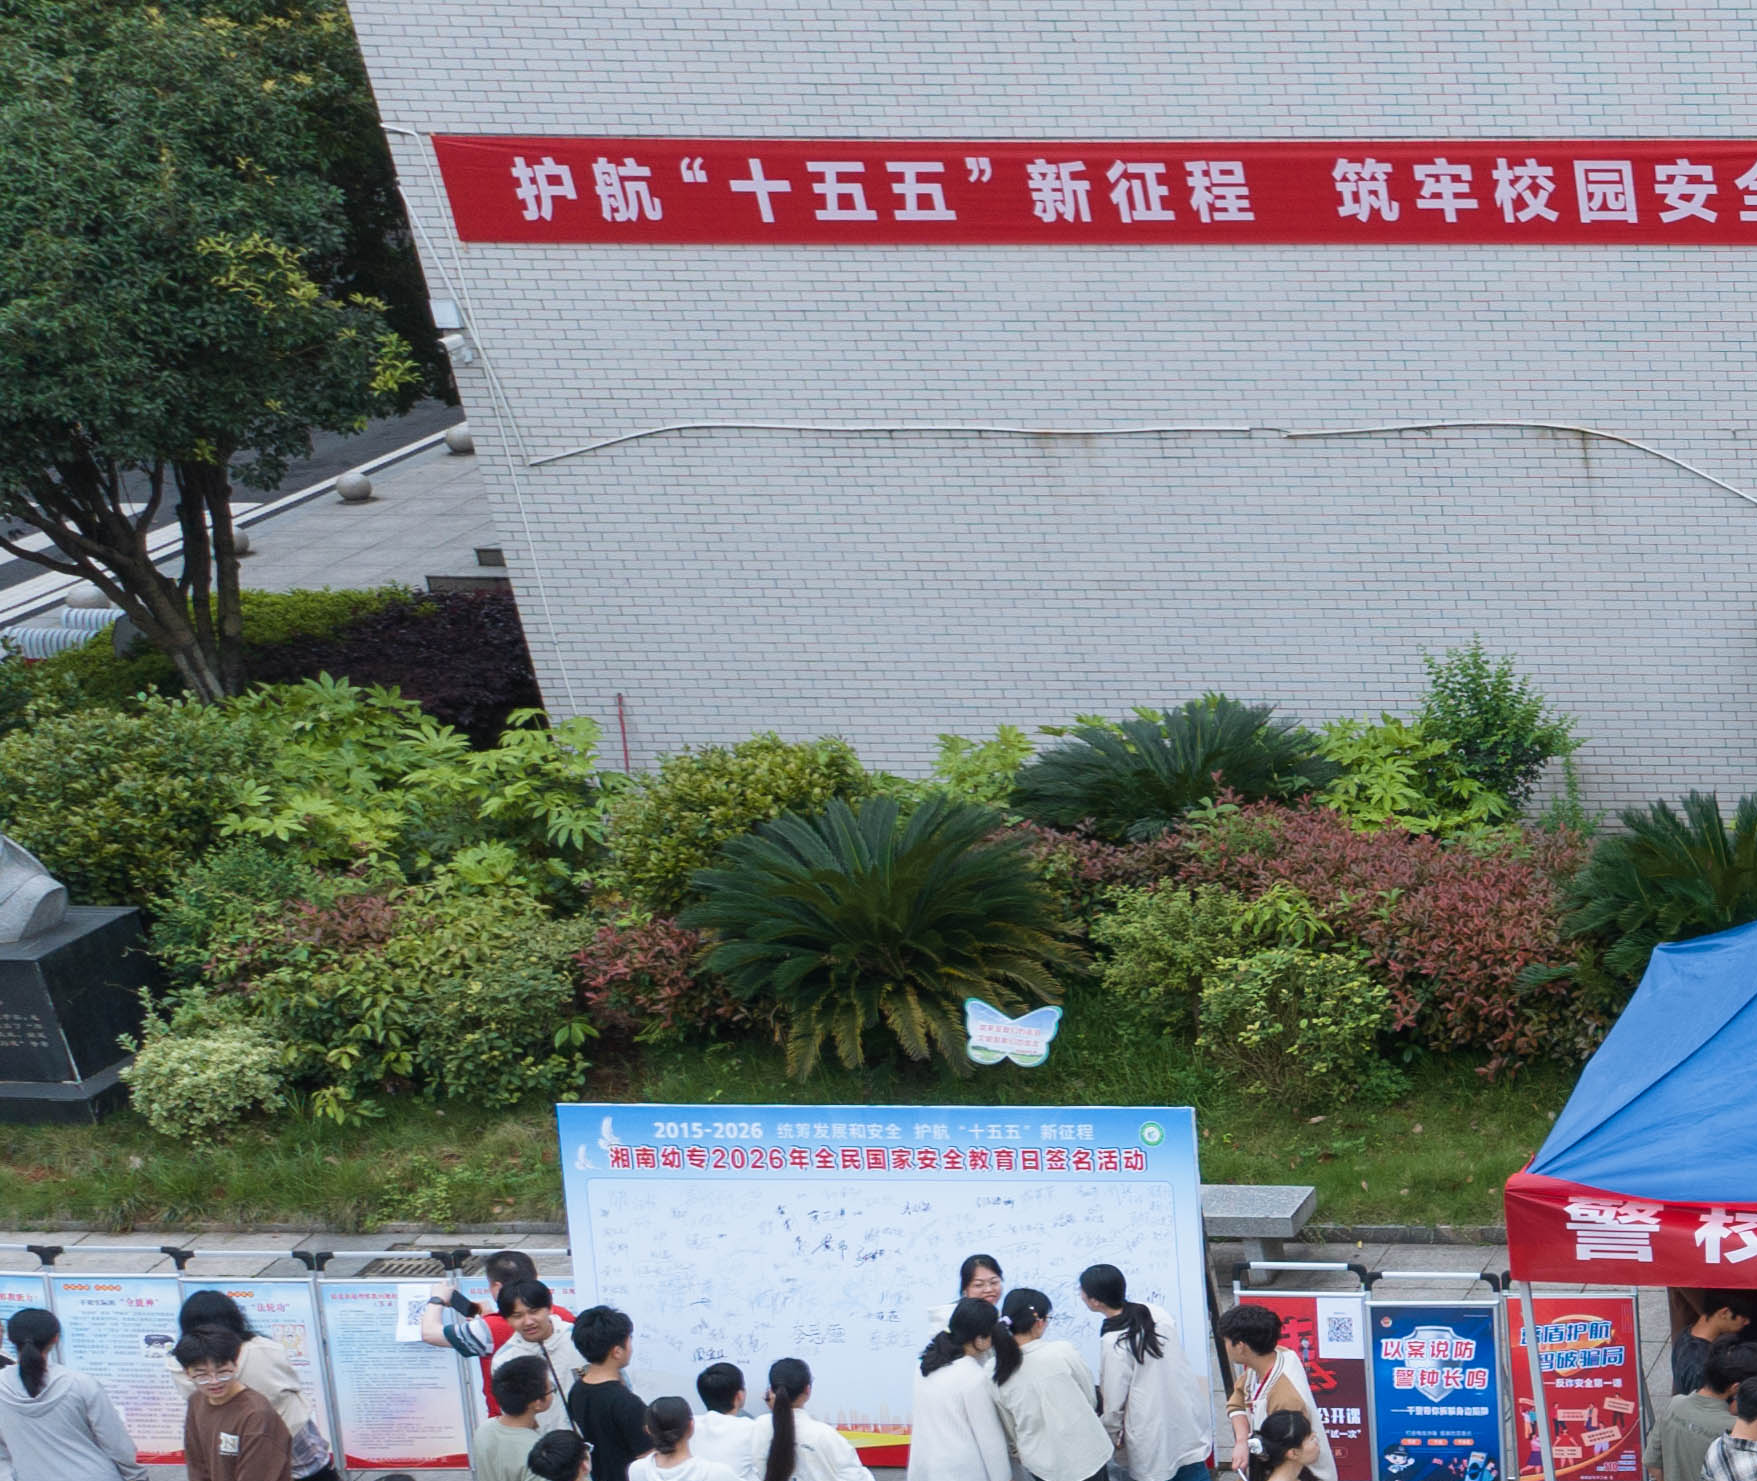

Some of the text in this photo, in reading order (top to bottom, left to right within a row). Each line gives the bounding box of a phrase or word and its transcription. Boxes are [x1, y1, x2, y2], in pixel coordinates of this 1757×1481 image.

[512, 157, 1254, 222] 护航“十五五”新征程
[654, 1123, 763, 1139] 2015-2026
[777, 1123, 901, 1139] 统筹发展和安全
[610, 1147, 1145, 1171] 湘南幼专2026年全民国家安全教育日签名活动
[1381, 1339, 1475, 1360] 以案说防
[1394, 1367, 1489, 1389] 警钟长鸣
